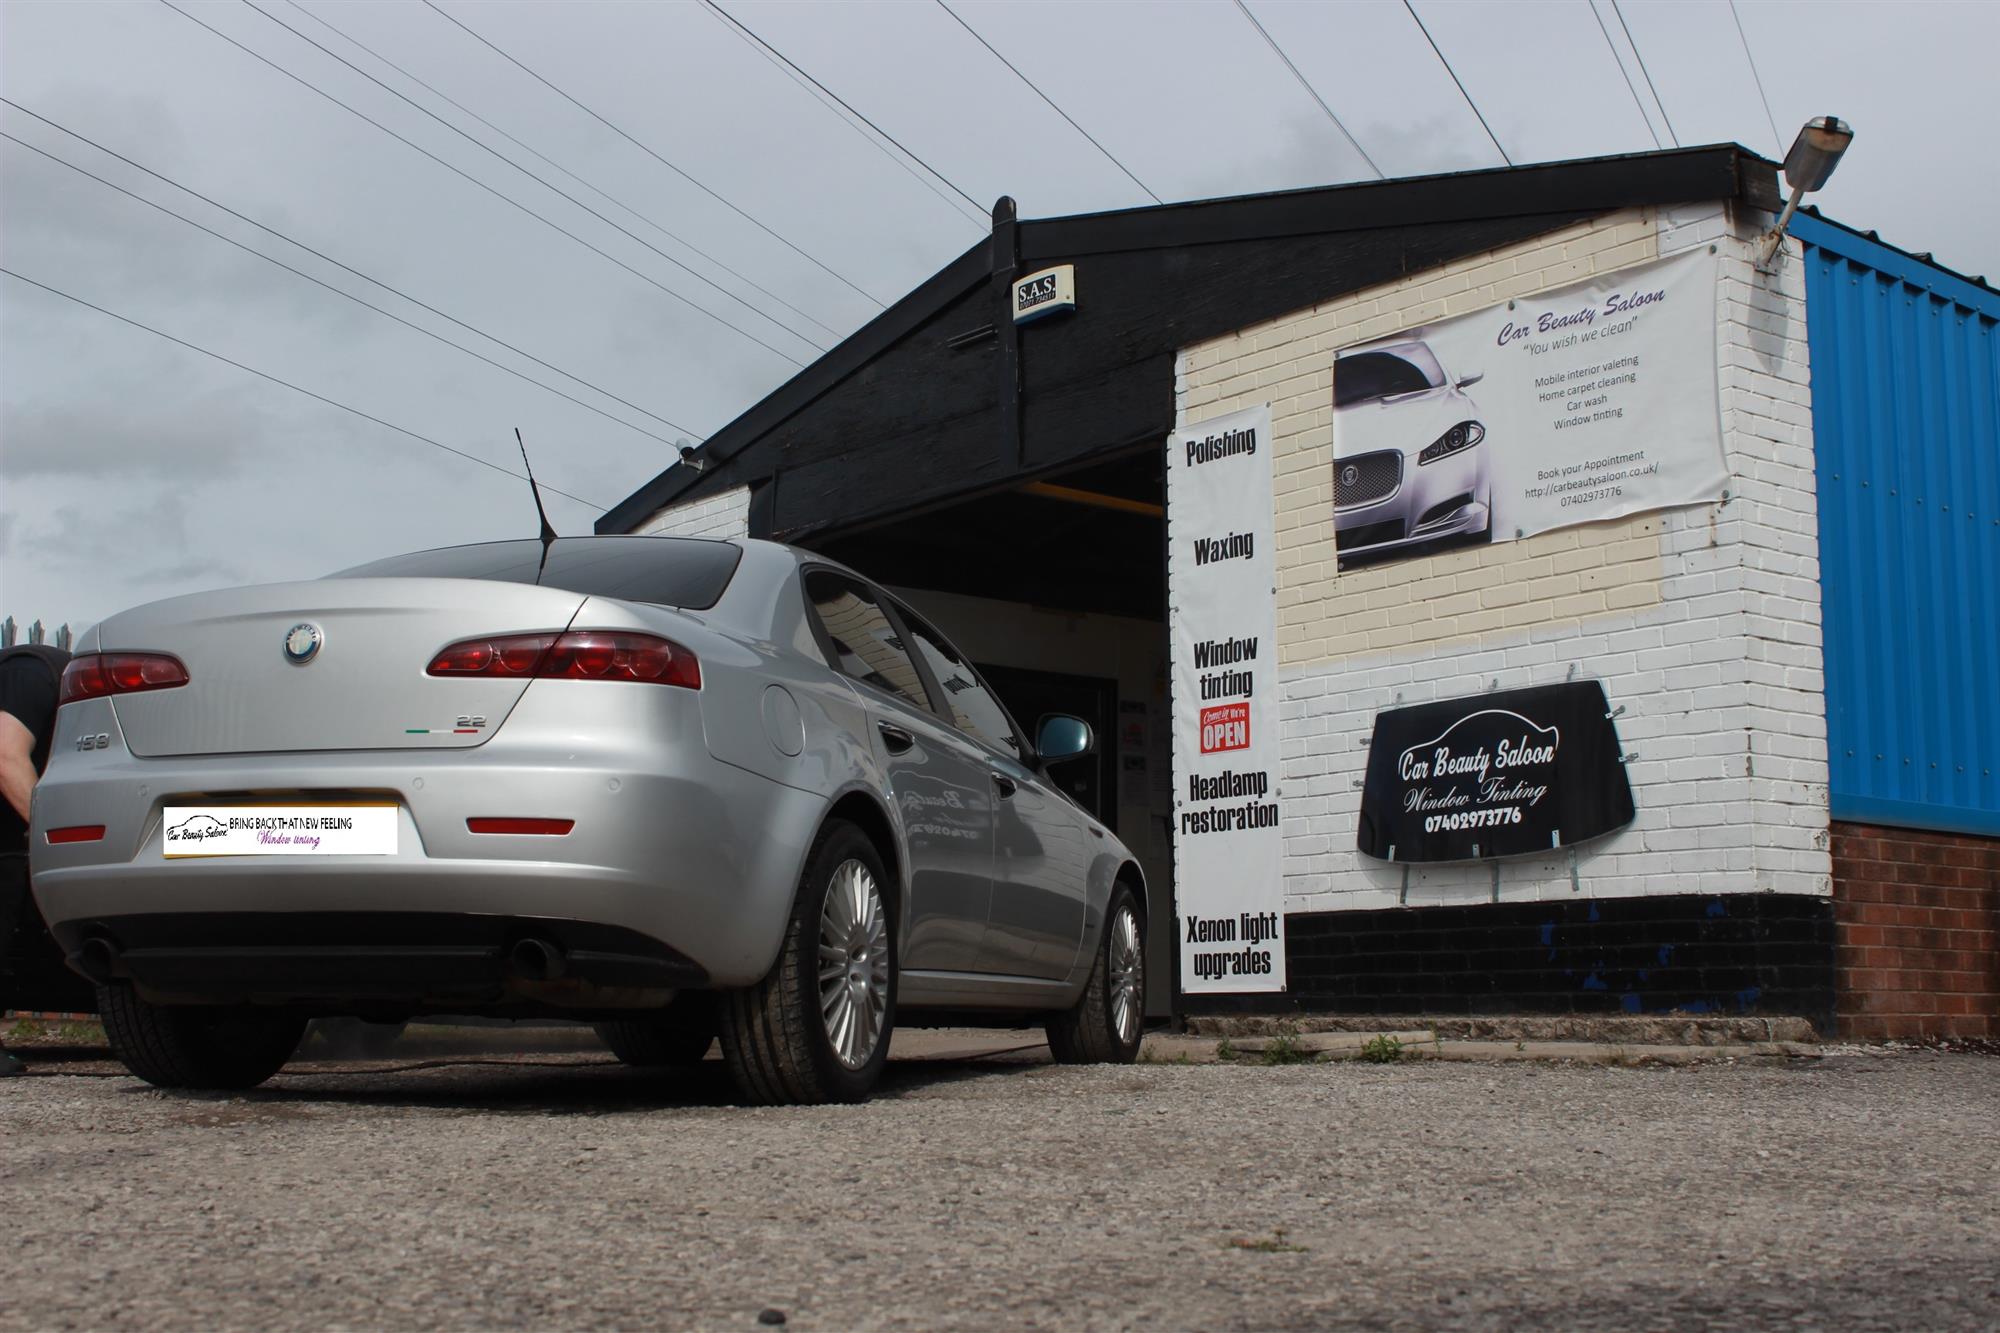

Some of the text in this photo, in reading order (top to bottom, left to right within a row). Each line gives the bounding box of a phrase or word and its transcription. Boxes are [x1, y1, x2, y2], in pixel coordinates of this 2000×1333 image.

[1497, 289, 1666, 346] Car Beauty Saloon
[1552, 331, 1577, 350] wish
[1581, 330, 1598, 343] we
[1535, 355, 1639, 388] Mobile interior valeting
[1539, 372, 1636, 403] Home carpet cleaning
[1553, 407, 1623, 430] Window tinting
[1567, 394, 1608, 412] Car wash
[1186, 428, 1257, 467] Polishing
[1525, 461, 1660, 499] http://carbeautysaloon.co.uk/
[1537, 451, 1645, 480] Book your Appointment
[1560, 485, 1622, 507] 07402973776
[1194, 532, 1254, 566] Waxing
[1194, 636, 1258, 669] Window
[1200, 670, 1253, 701] tinting
[1203, 721, 1246, 750] OPEN
[1402, 735, 1554, 783] Car Beauty Saloon
[1189, 770, 1268, 801] Headlamp
[1403, 776, 1547, 813] Window Tinting
[1182, 801, 1279, 835] restoration
[1425, 807, 1522, 833] 07402973776
[1187, 912, 1278, 945] Xenon light
[1194, 946, 1271, 980] upgrades
